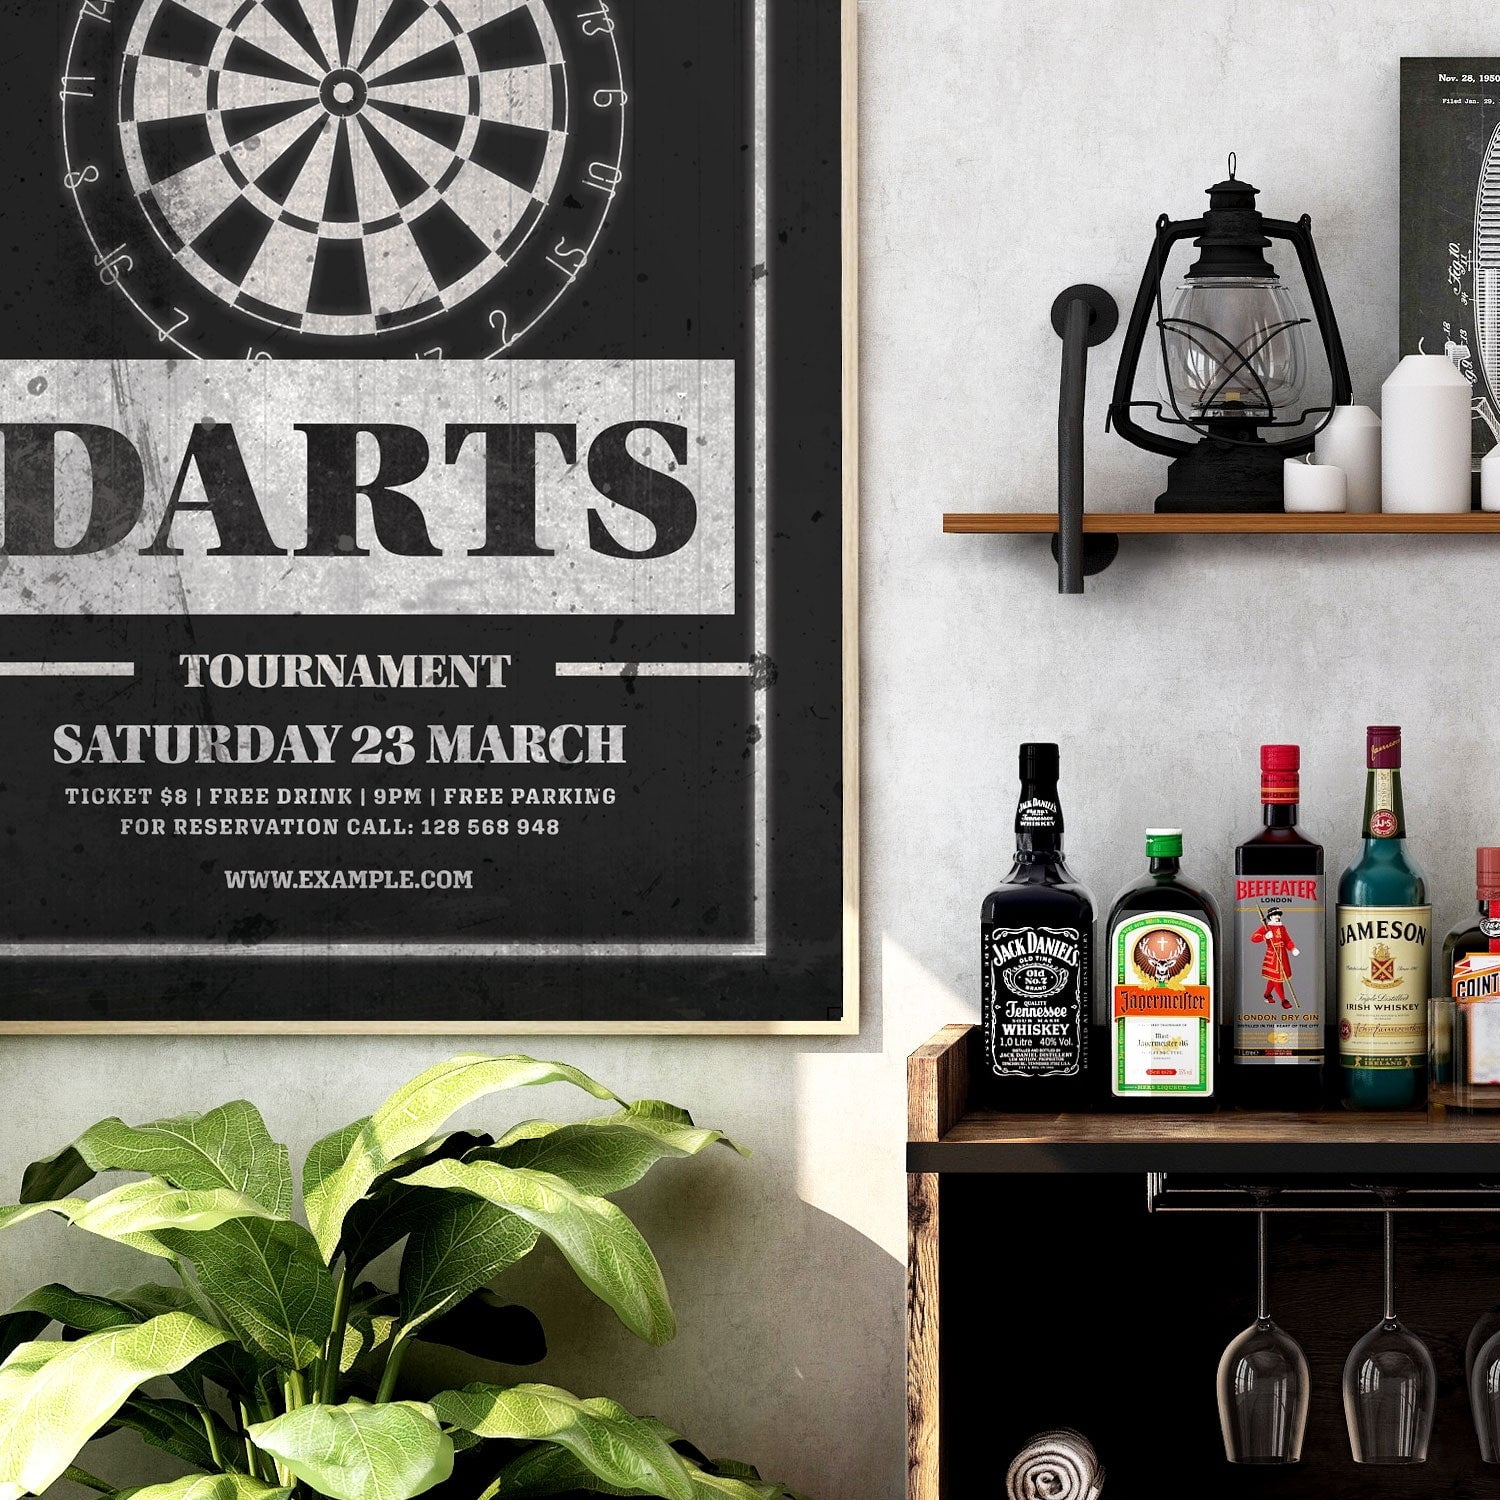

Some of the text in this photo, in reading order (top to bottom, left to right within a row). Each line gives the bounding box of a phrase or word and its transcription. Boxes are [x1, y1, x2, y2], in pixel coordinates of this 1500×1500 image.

[1438, 73, 1459, 82] Nov.
[1461, 74, 1476, 83] 28,
[64, 165, 99, 189] 8
[0, 420, 698, 560] DARTS
[179, 653, 511, 689] TOURNAMENT
[53, 723, 627, 766] SATURDAY 23 MARCH
[65, 786, 616, 807] TICKET $8 FREE DRINK 9PM FREE PARKING
[120, 818, 560, 836] FOR RESERVATION CALL: 128 568 948
[224, 870, 474, 889] WWW.EXAMPLE.COM
[1235, 879, 1318, 901] BEEFEATER
[1339, 920, 1427, 948] JAMESON
[992, 937, 1027, 967] JACK
[1025, 969, 1045, 978] Old
[1005, 1000, 1068, 1018] Tennessee
[1346, 1003, 1420, 1011] IRISH WHISKEY
[1001, 1023, 1070, 1036] WHISKEY
[1000, 1037, 1074, 1047] 1.0 Litre 40% Vol.
